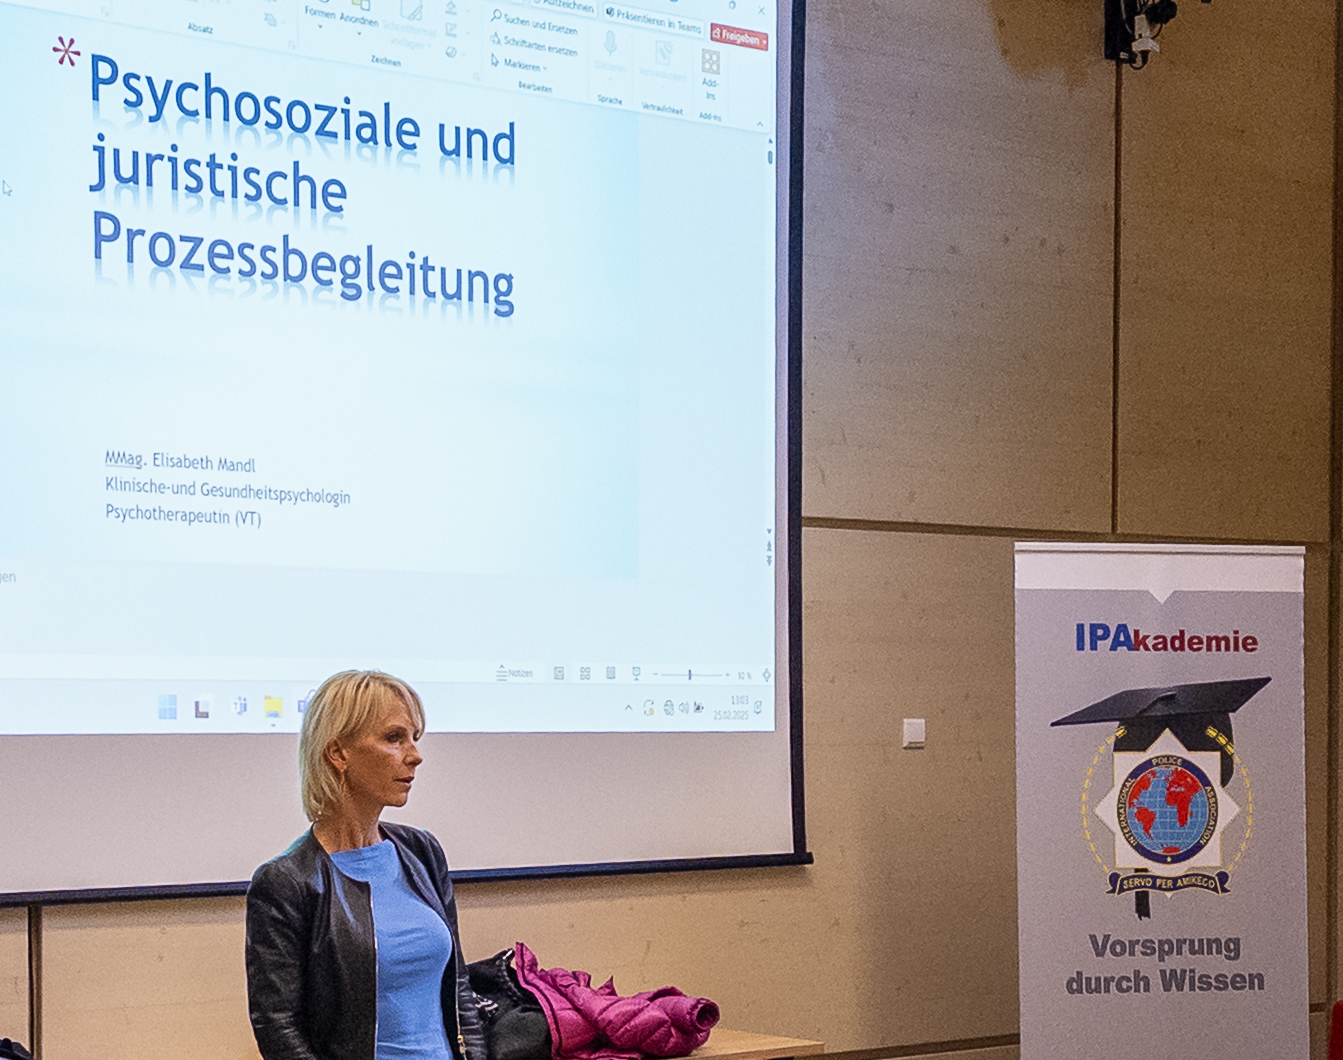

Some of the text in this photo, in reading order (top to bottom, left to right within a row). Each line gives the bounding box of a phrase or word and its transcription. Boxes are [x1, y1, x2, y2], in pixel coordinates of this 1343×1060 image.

[305, 5, 336, 20] Formen
[340, 12, 379, 28] Anordnen
[616, 9, 702, 34] Präsentieren in Teams
[187, 22, 213, 35] Absatz
[504, 14, 578, 35] Suchen und Ersetzen
[722, 29, 760, 45] Freigeben
[371, 55, 401, 67] Zeichnen
[548, 45, 578, 57] ersetzen
[504, 58, 541, 72] Markieren
[519, 81, 552, 93] Bearbeiten
[90, 54, 516, 166] Psychosoziale und
[597, 94, 622, 105] Sprache
[89, 133, 348, 214] juristische
[93, 210, 515, 317] Prozessbegleitung
[105, 450, 256, 473] MMag. Elisabeth Mandl
[105, 476, 351, 507] Klinische-und Gesundheitspsychologin
[106, 504, 262, 529] Psychotherapeutin (VT)
[1075, 623, 1259, 652] IPAkademie
[1118, 756, 1218, 847] INTERNATIONAL POLICE ASSOCIATION
[1123, 876, 1216, 889] SERVO PER AMIKECO
[1089, 934, 1242, 962] Vorsprung
[1065, 968, 1265, 995] durch Wissen
